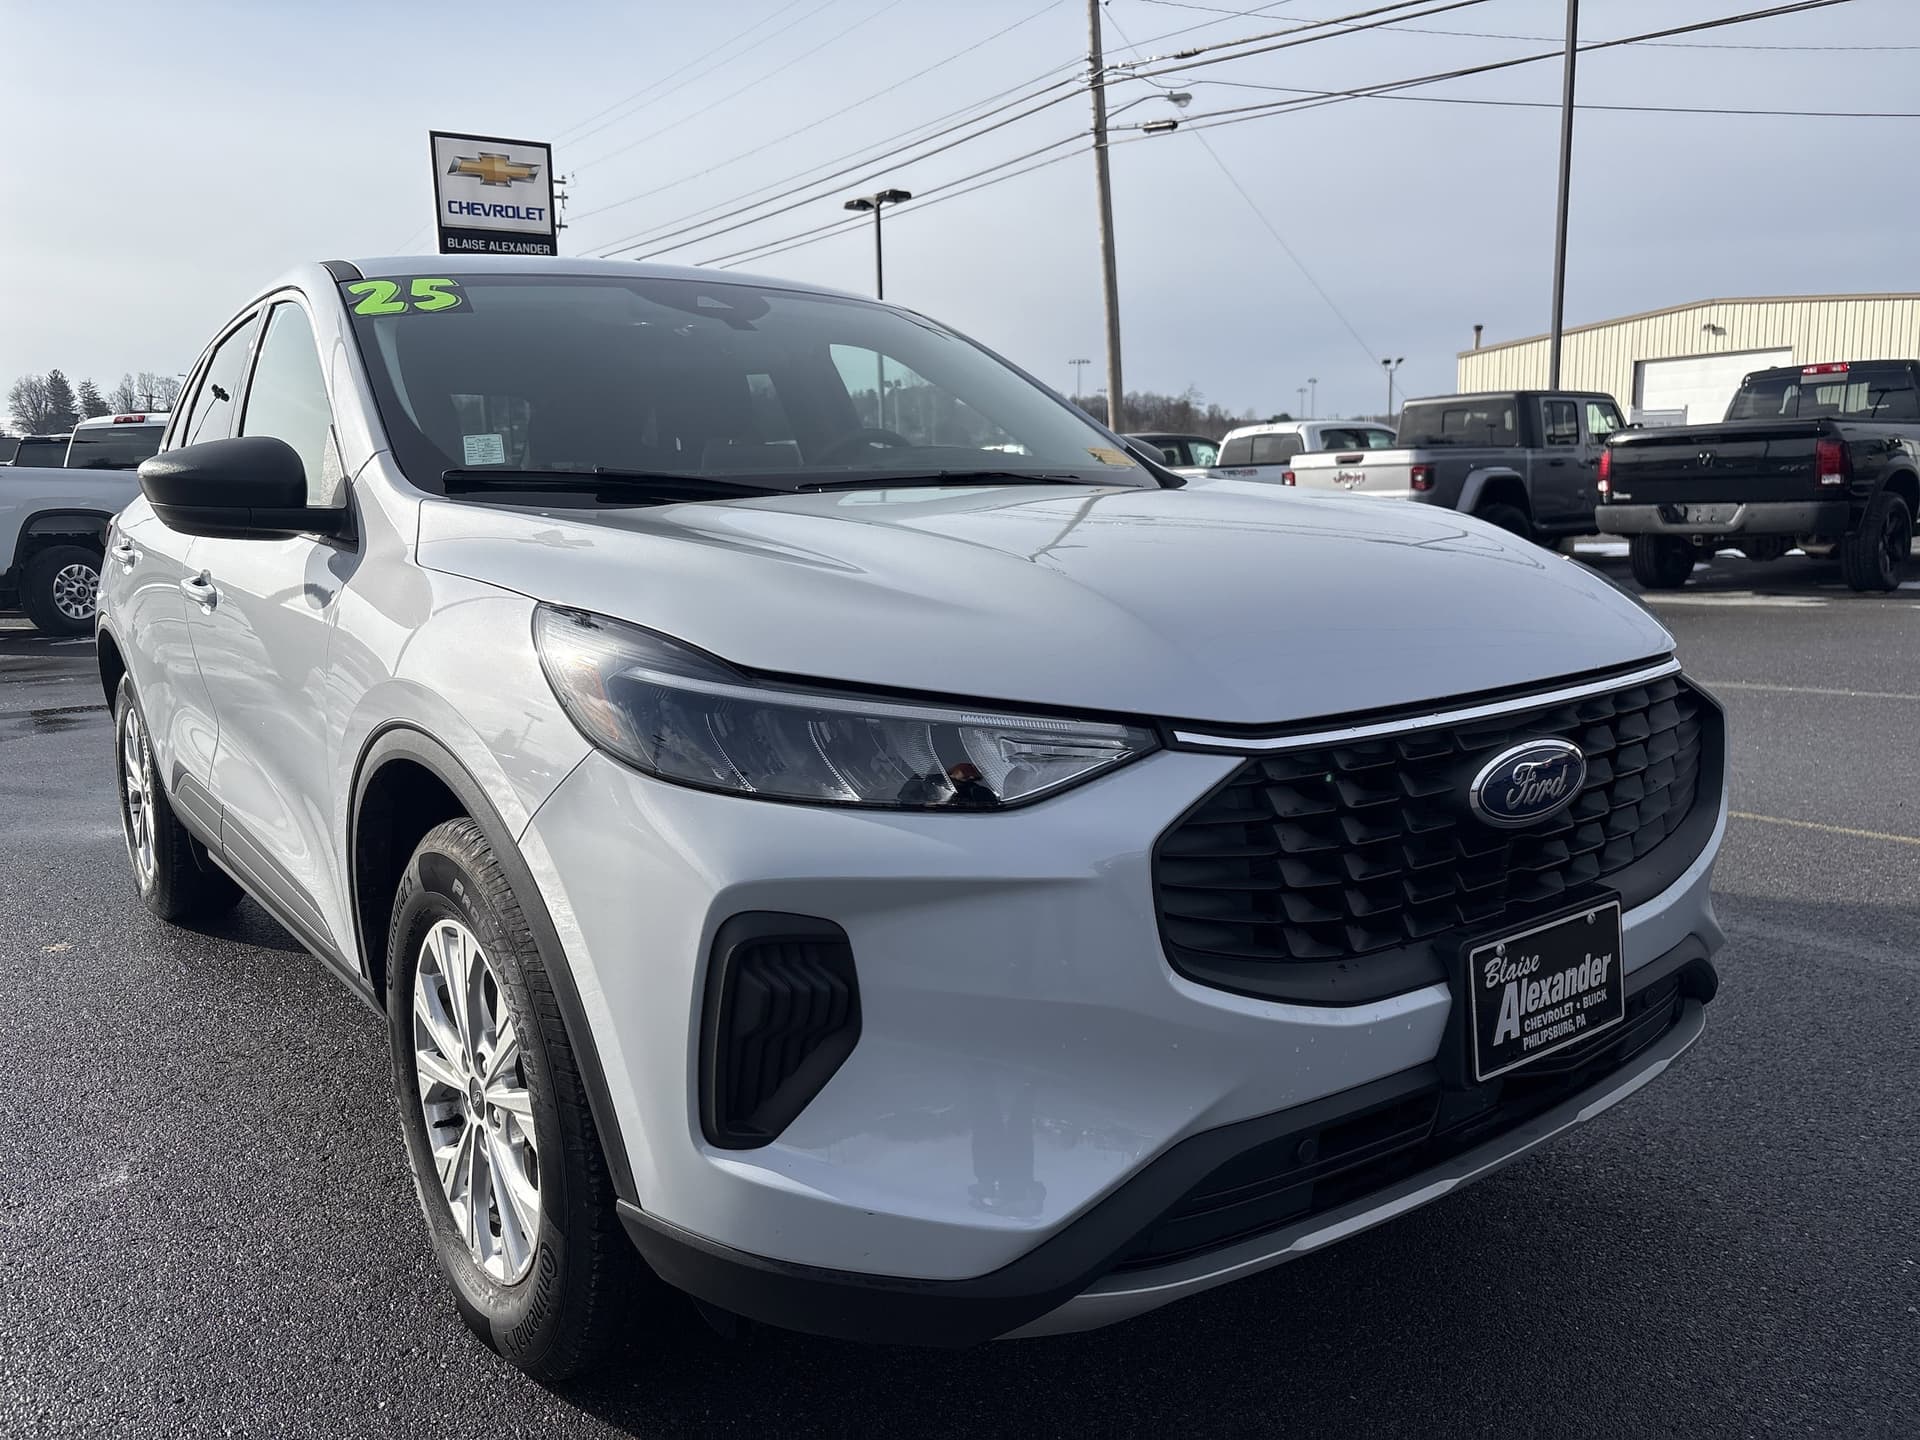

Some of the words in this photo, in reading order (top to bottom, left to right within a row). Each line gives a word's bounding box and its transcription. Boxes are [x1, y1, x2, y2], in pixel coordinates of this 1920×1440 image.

[447, 200, 545, 221] CHEVROLET
[447, 237, 486, 250] BLAISE
[489, 241, 551, 255] ALEXANDER
[347, 278, 462, 315] 25
[1505, 756, 1569, 811] Ford
[1484, 954, 1541, 989] Blaise
[1493, 952, 1612, 1047] Alexander
[1524, 1002, 1574, 1033] CHEVROLET
[1582, 989, 1607, 1009] BUICK
[1575, 1013, 1587, 1029] PA
